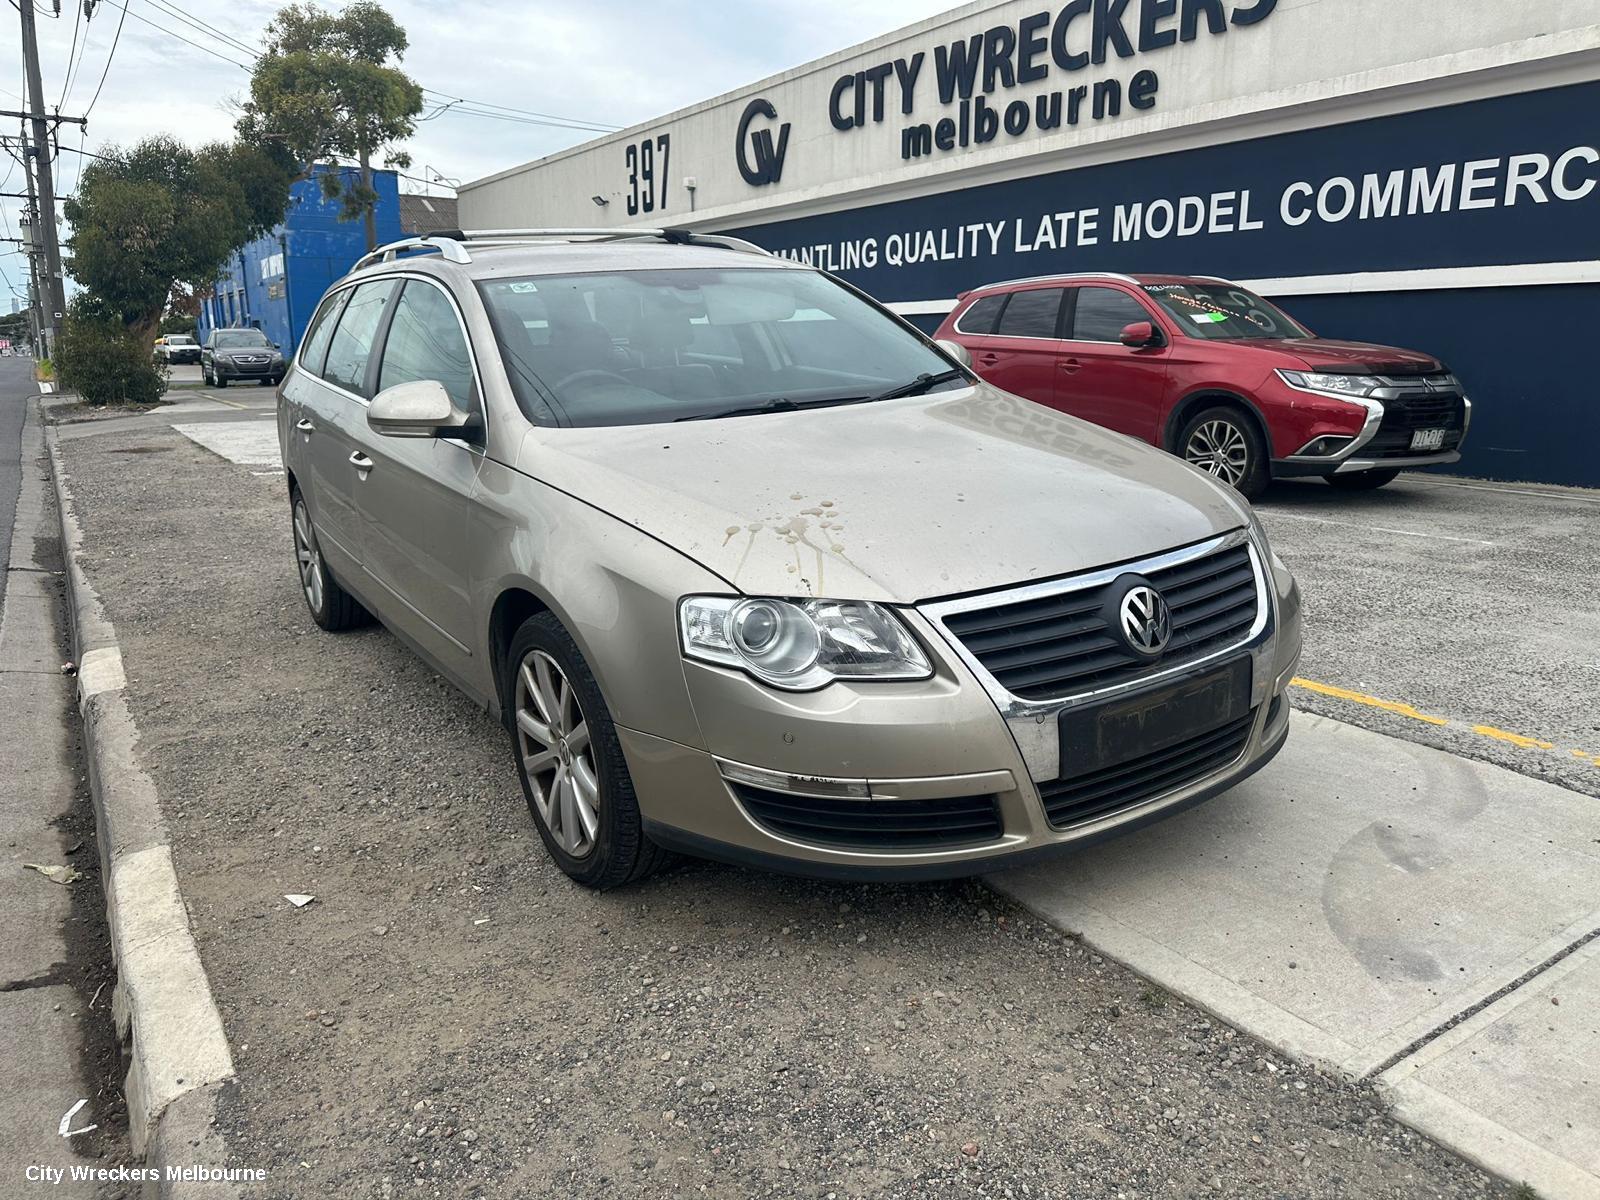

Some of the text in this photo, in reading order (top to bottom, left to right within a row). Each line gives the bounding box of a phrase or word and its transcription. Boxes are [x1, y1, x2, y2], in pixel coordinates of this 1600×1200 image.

[829, 52, 925, 131] CITY
[902, 69, 1158, 159] melbourne
[626, 134, 670, 216] 397
[885, 221, 1005, 267] QUALITY
[1014, 208, 1099, 252] LATE
[1112, 190, 1264, 243] MODEL
[1280, 146, 1600, 226] COMMERC
